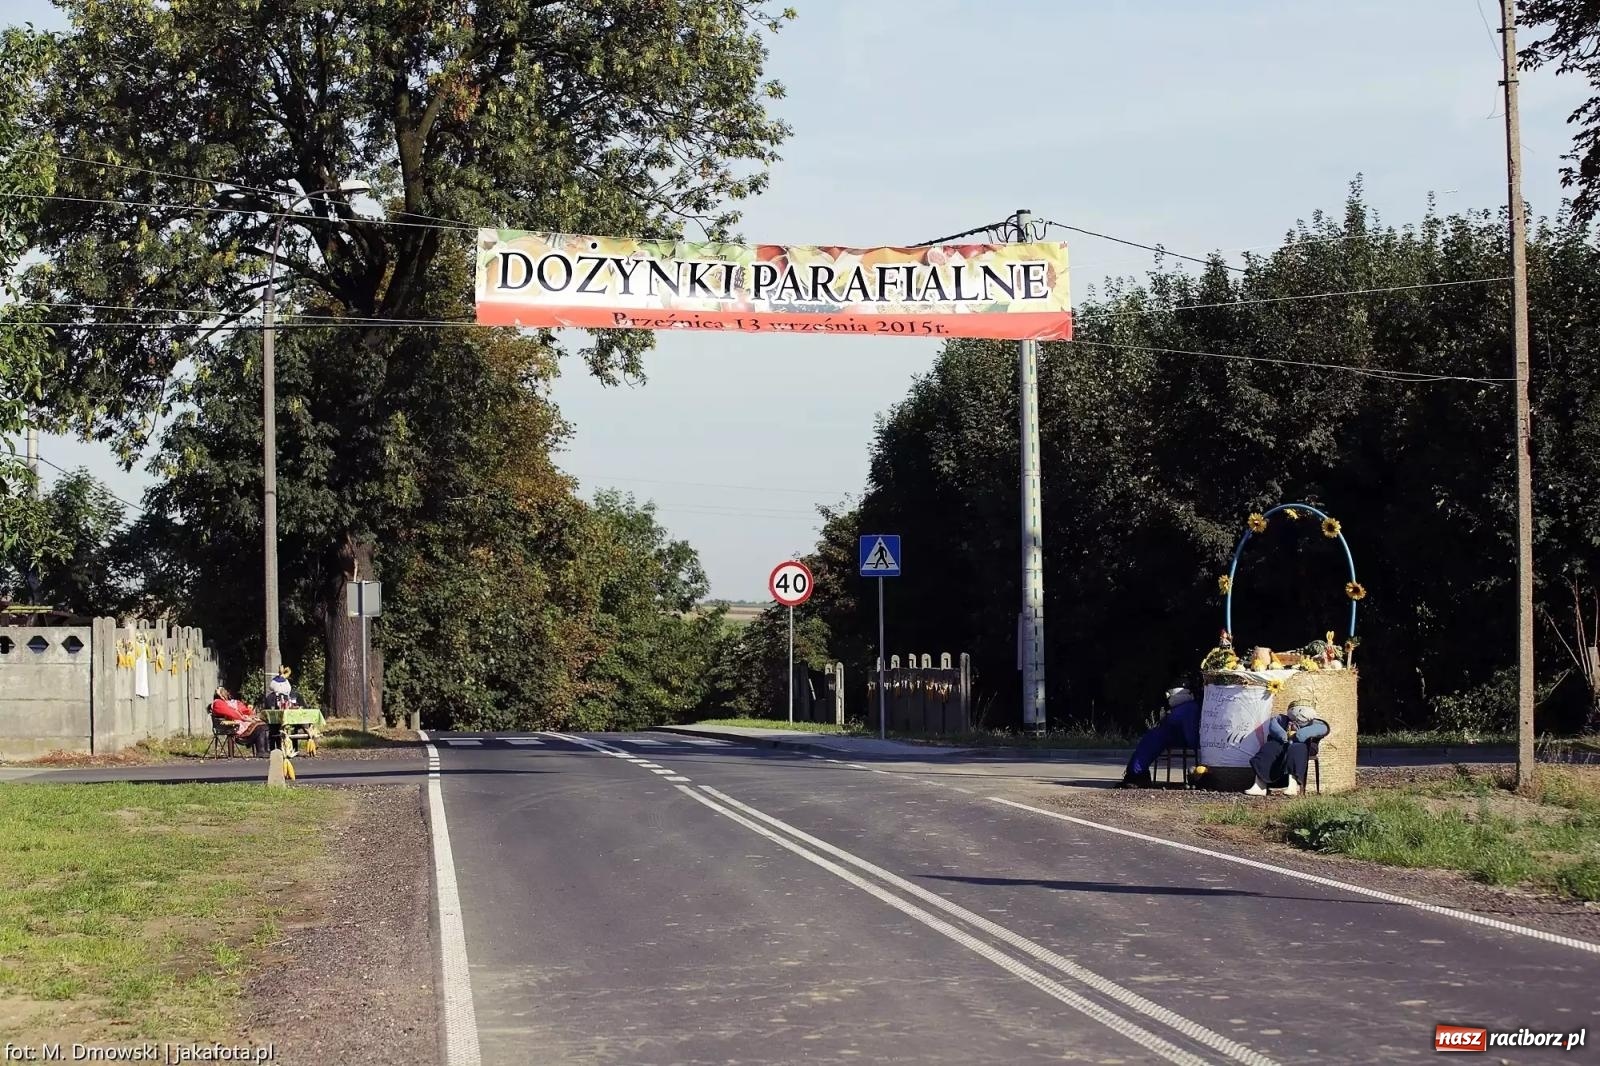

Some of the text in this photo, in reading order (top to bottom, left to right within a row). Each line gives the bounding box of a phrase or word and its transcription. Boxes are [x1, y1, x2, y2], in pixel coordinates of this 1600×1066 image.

[497, 242, 1049, 302] DOŻYNKI PARAFIALNE
[735, 318, 761, 331] 13
[769, 317, 868, 332] września
[876, 320, 950, 335] 2015r.
[775, 573, 807, 593] 40
